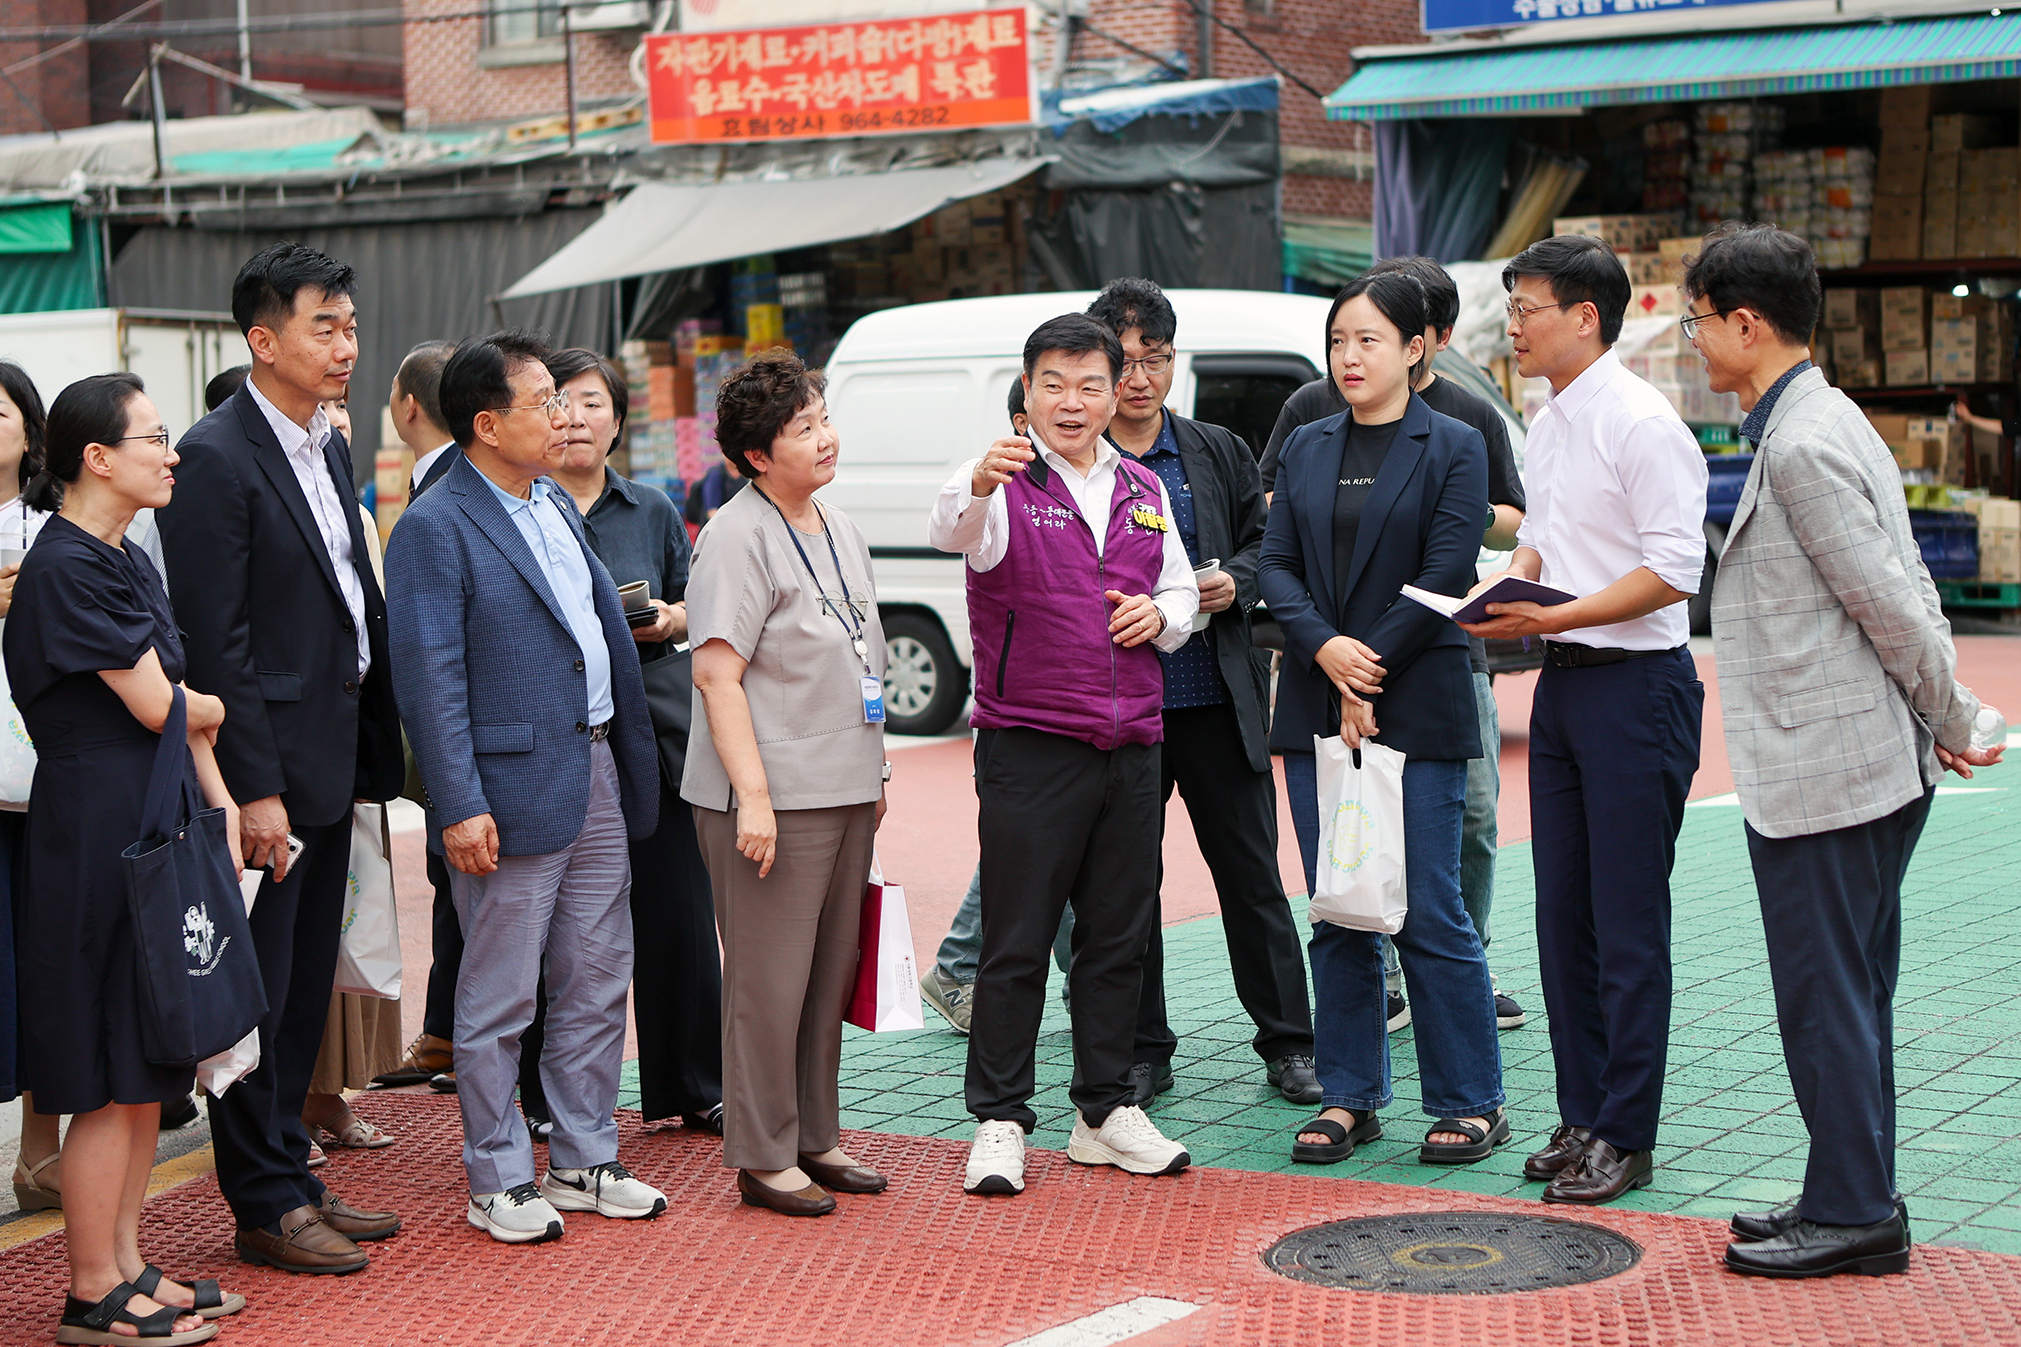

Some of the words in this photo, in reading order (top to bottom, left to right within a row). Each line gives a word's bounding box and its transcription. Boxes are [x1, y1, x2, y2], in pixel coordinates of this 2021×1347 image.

[930, 58, 998, 102] 특판
[840, 106, 950, 130] 964-4282
[1352, 477, 1376, 486] REPU
